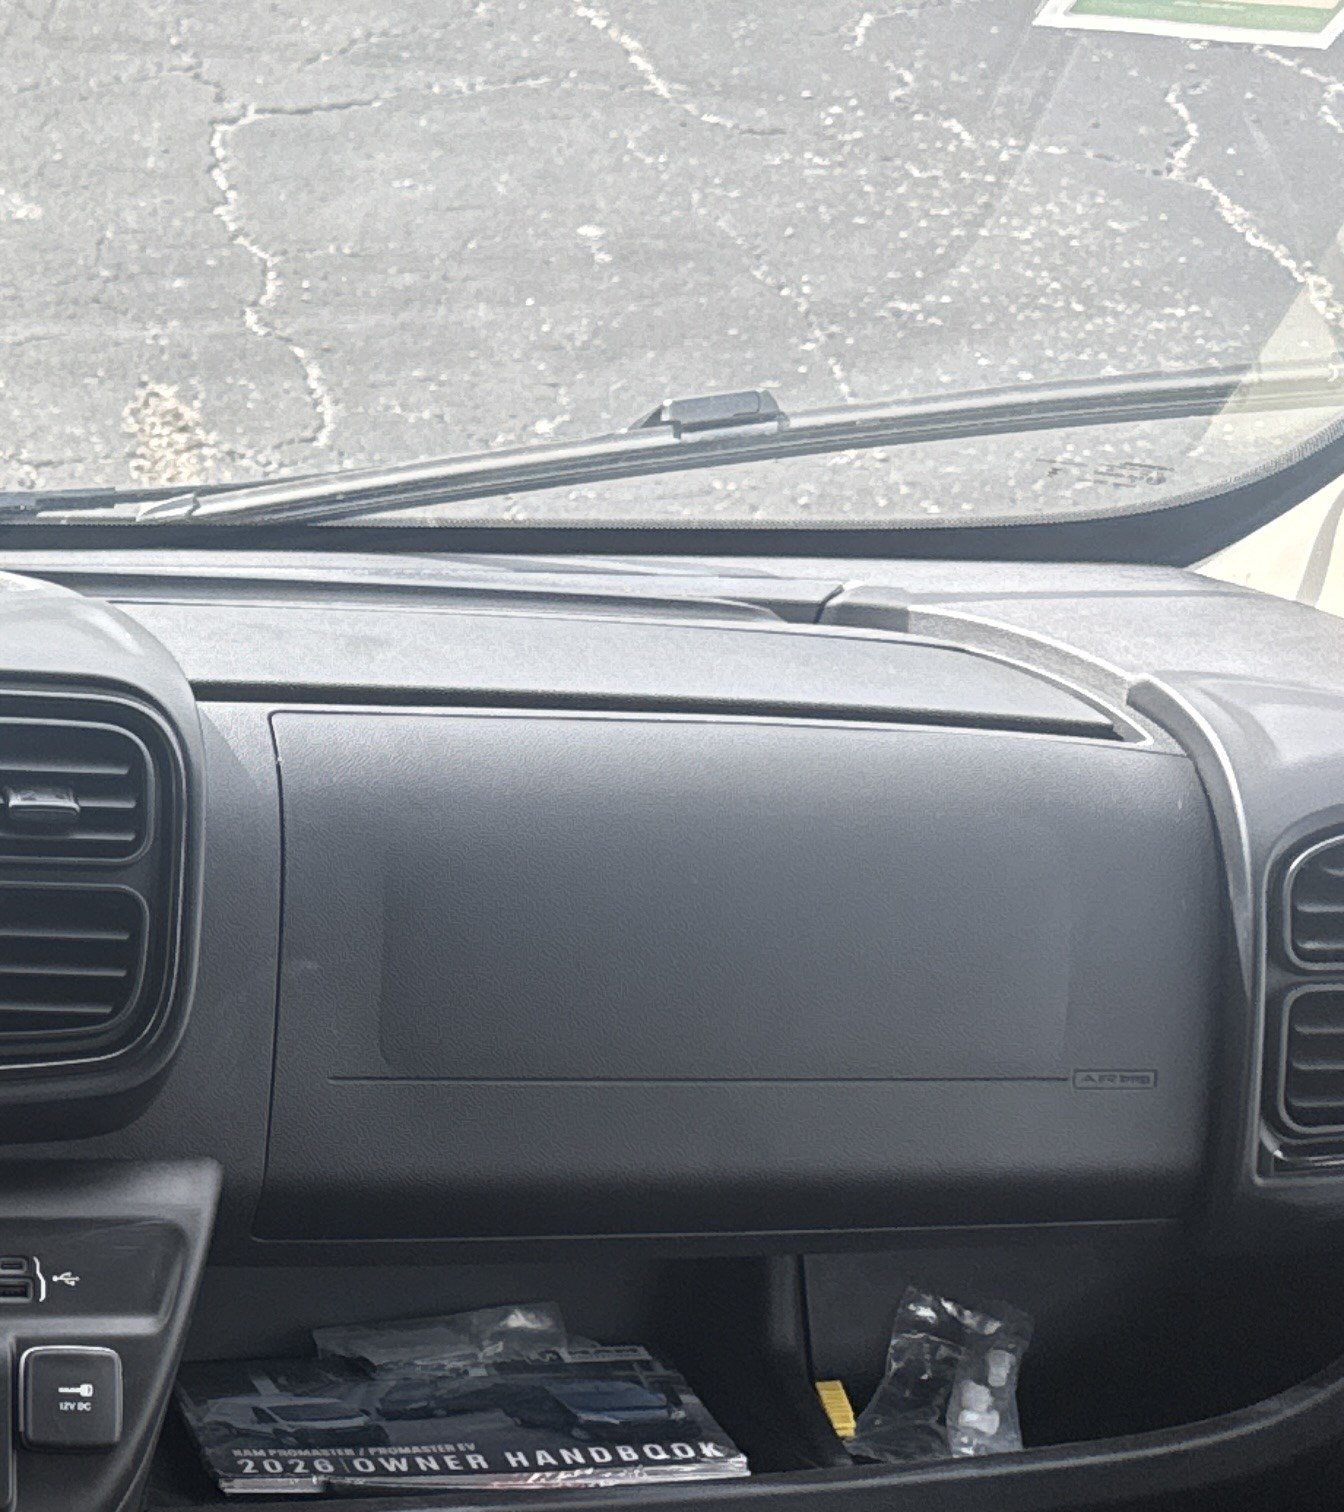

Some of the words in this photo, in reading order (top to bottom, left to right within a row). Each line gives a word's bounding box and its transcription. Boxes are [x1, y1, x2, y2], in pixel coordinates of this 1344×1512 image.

[231, 1447, 268, 1459] RAM
[268, 1447, 355, 1458] PROMASTER
[368, 1443, 458, 1456] PROMASTER
[458, 1442, 477, 1454] EV
[237, 1457, 337, 1475] 2026
[357, 1453, 490, 1474] OWNER
[507, 1441, 727, 1470] HANDBOOK
